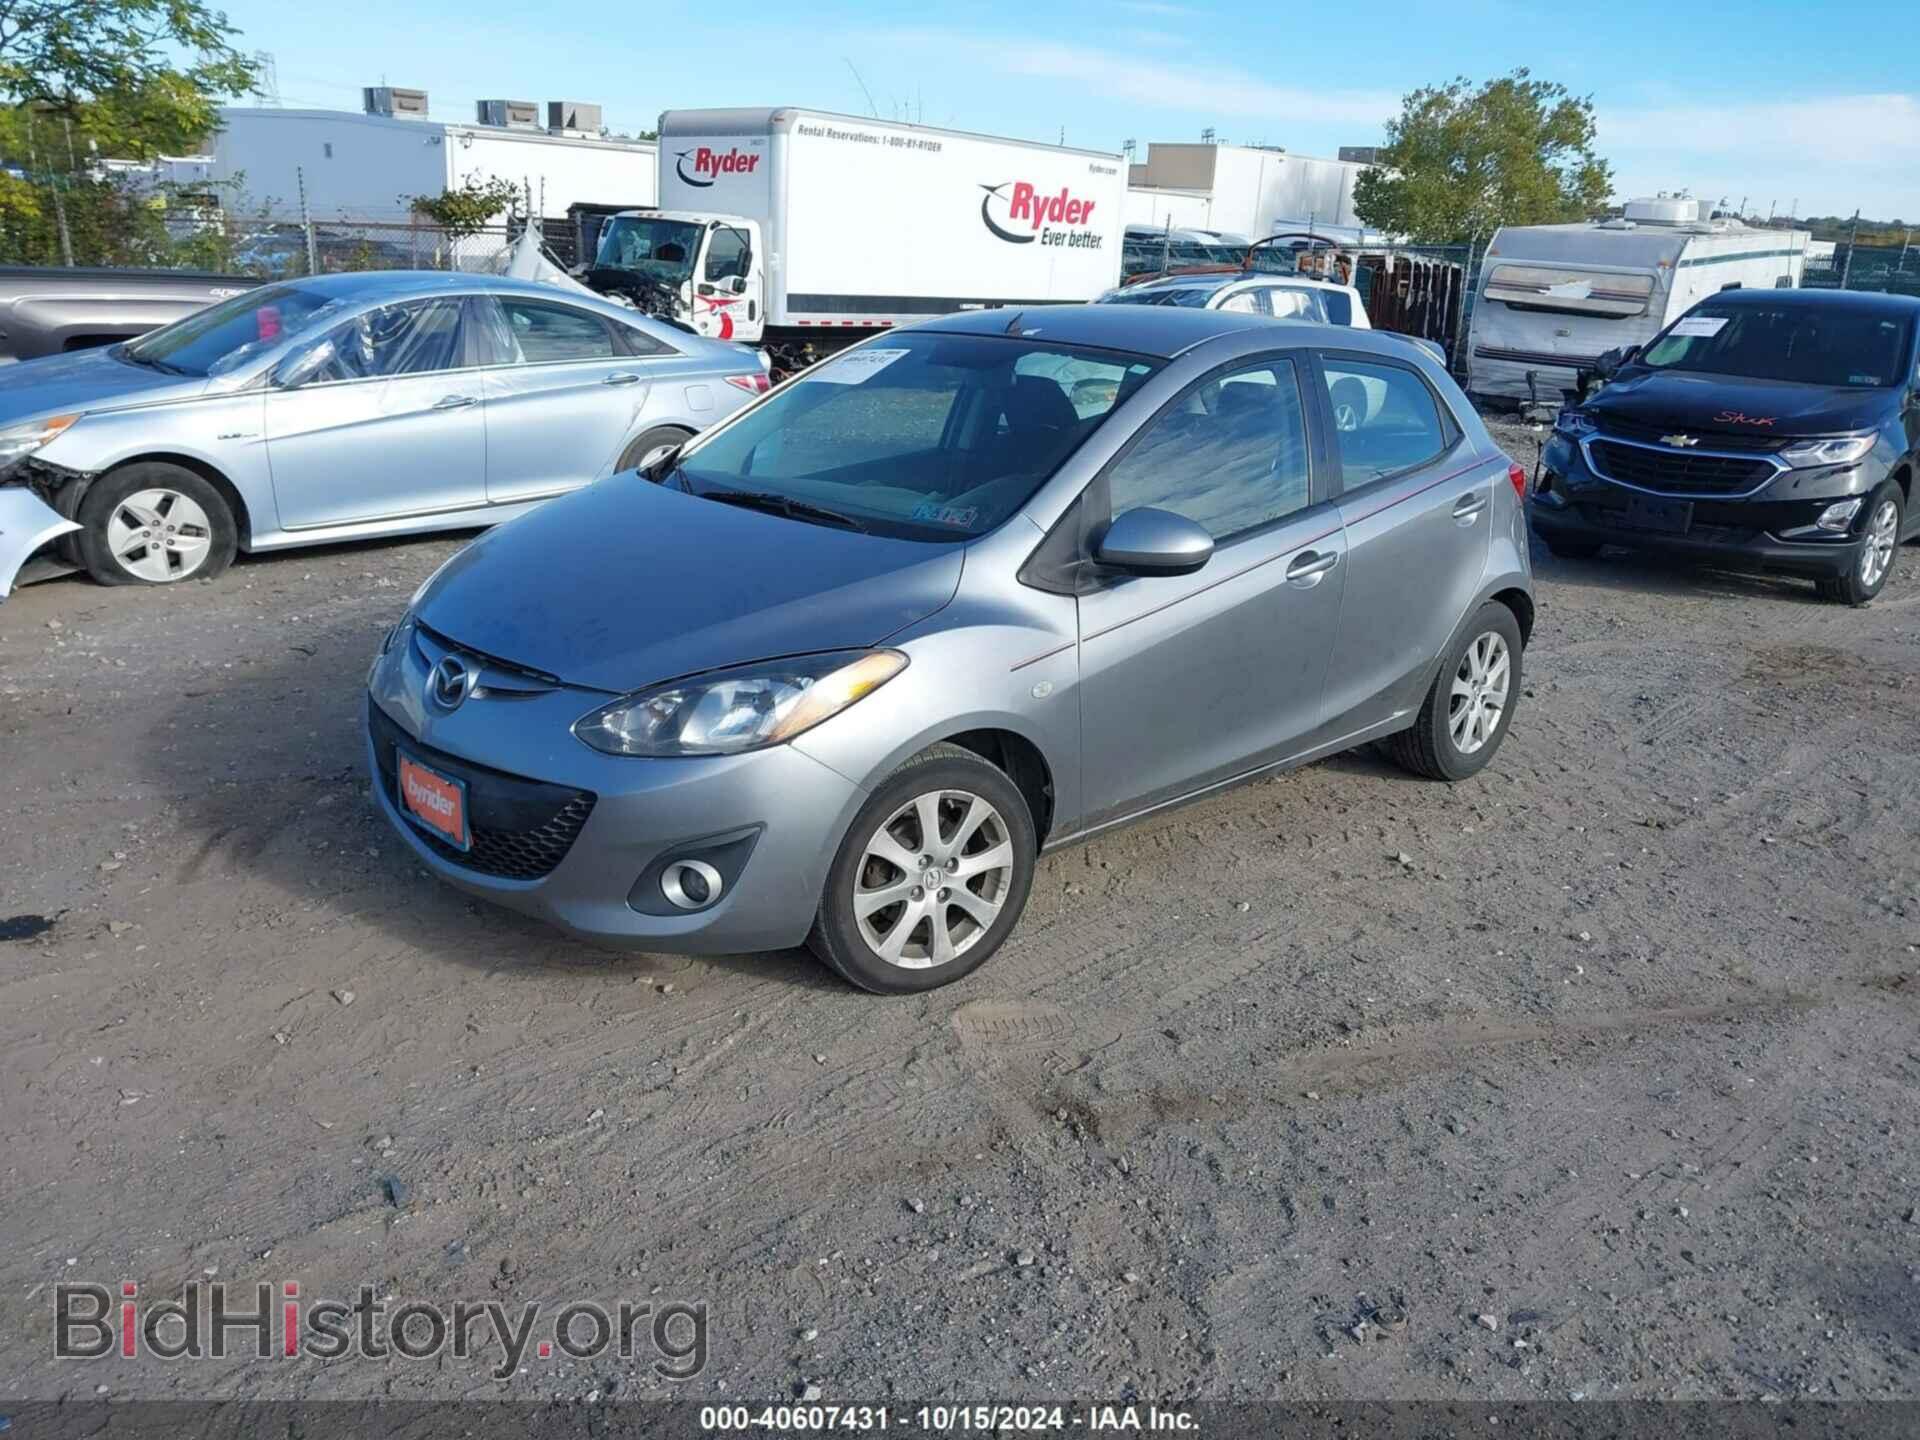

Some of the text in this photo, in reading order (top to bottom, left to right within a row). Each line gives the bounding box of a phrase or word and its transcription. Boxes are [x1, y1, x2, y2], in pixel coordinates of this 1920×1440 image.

[797, 124, 824, 137] Rental
[826, 127, 880, 144] Reservations:
[695, 147, 760, 178] Ryder
[1009, 182, 1096, 230] Ryder
[1041, 227, 1103, 249] Ever better.
